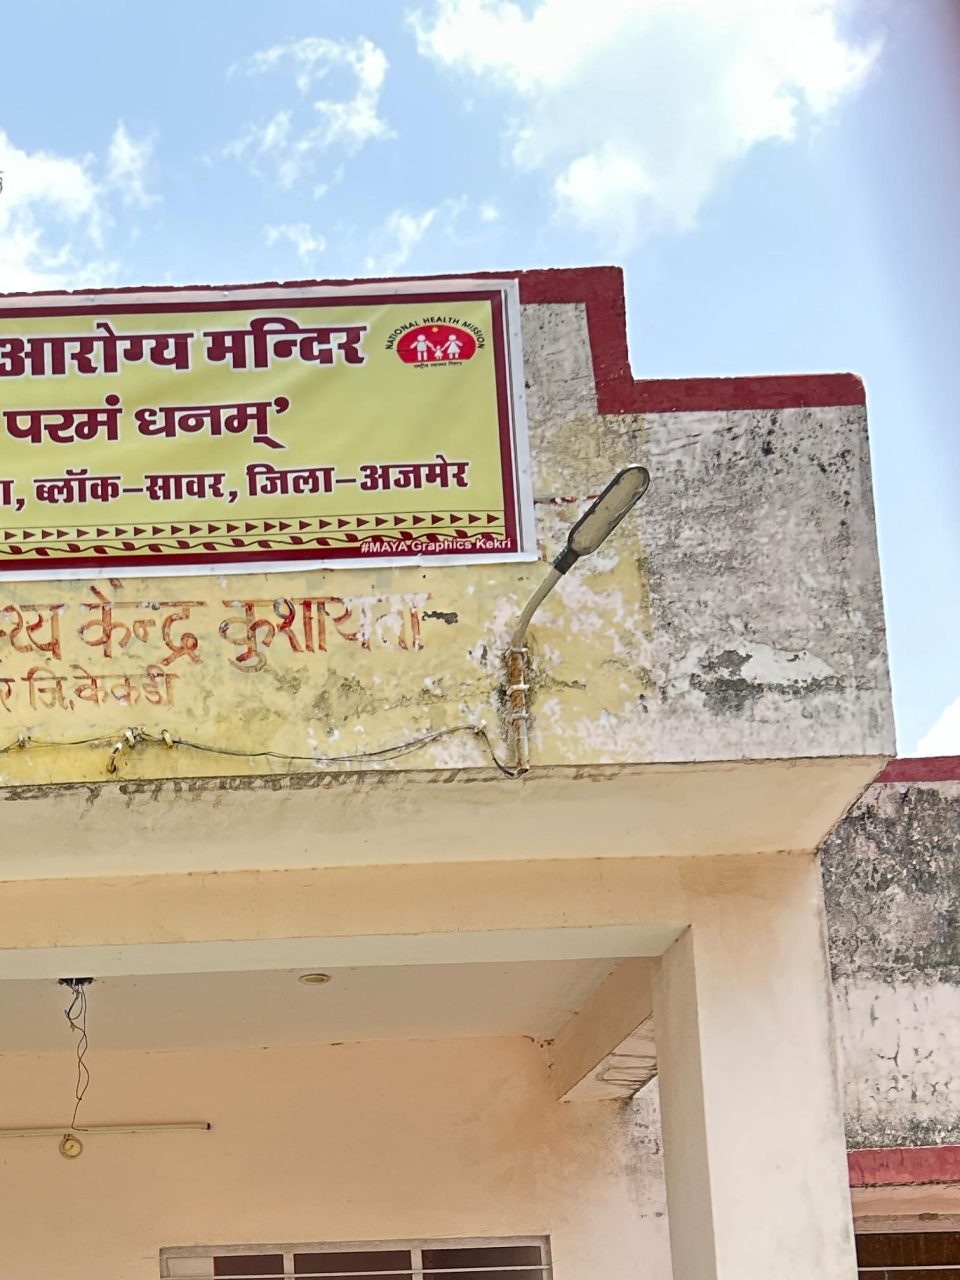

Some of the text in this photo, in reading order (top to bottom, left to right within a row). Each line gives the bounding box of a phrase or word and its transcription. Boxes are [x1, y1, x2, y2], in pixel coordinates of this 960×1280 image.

[204, 317, 367, 369] मन्दिर
[385, 316, 485, 350] NATIONAL HEALTH MISSION
[4, 394, 122, 443] परमं
[361, 538, 511, 553] #MAYA Graphics Kekri
[80, 582, 207, 666] केन्द्र
